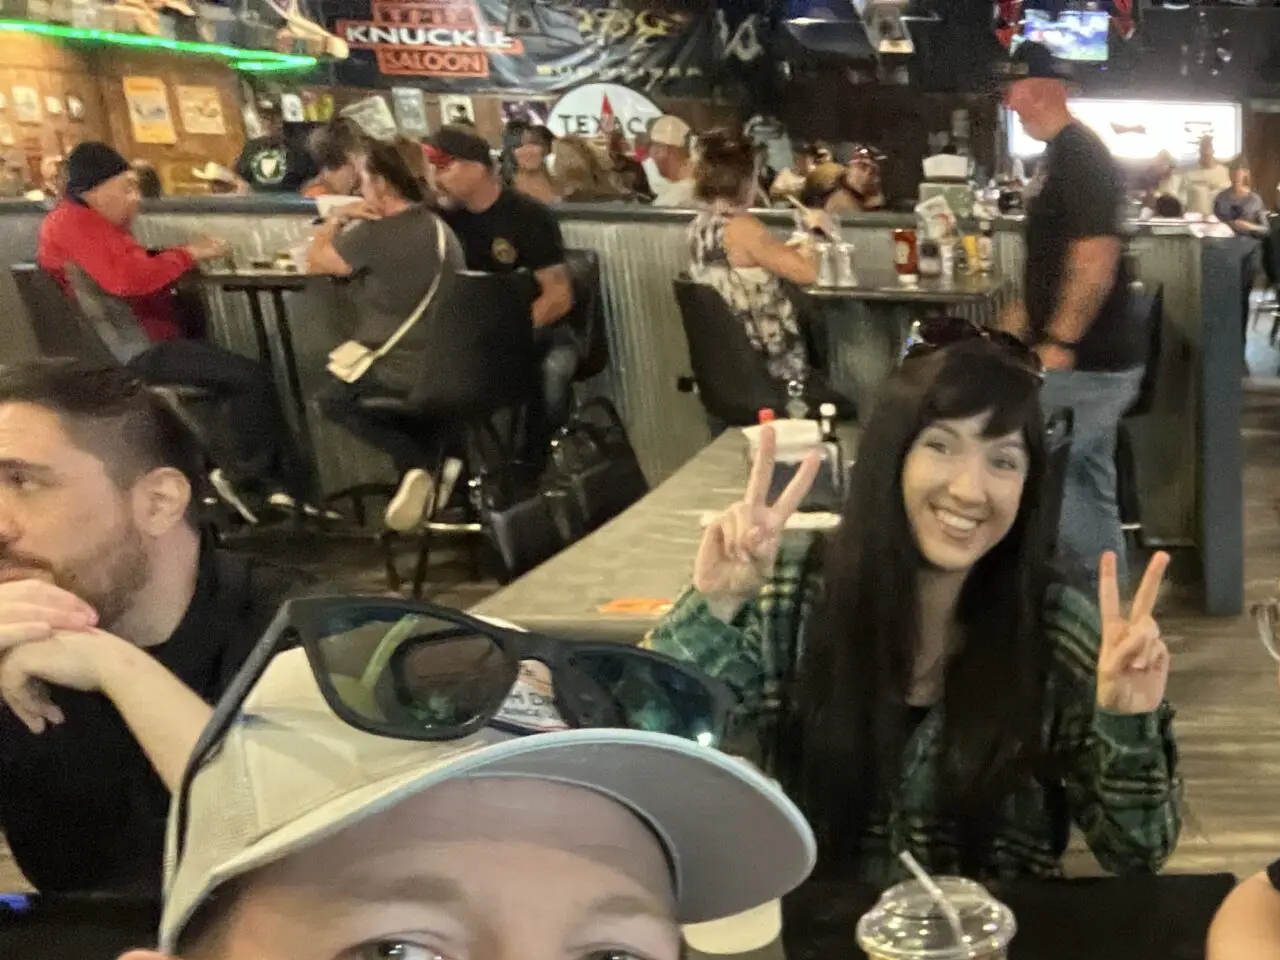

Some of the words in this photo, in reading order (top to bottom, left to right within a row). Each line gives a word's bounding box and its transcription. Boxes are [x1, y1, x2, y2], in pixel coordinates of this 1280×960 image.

[346, 27, 513, 48] KNUCKLE
[383, 51, 481, 72] SALOON
[557, 114, 651, 136] TEXAC
